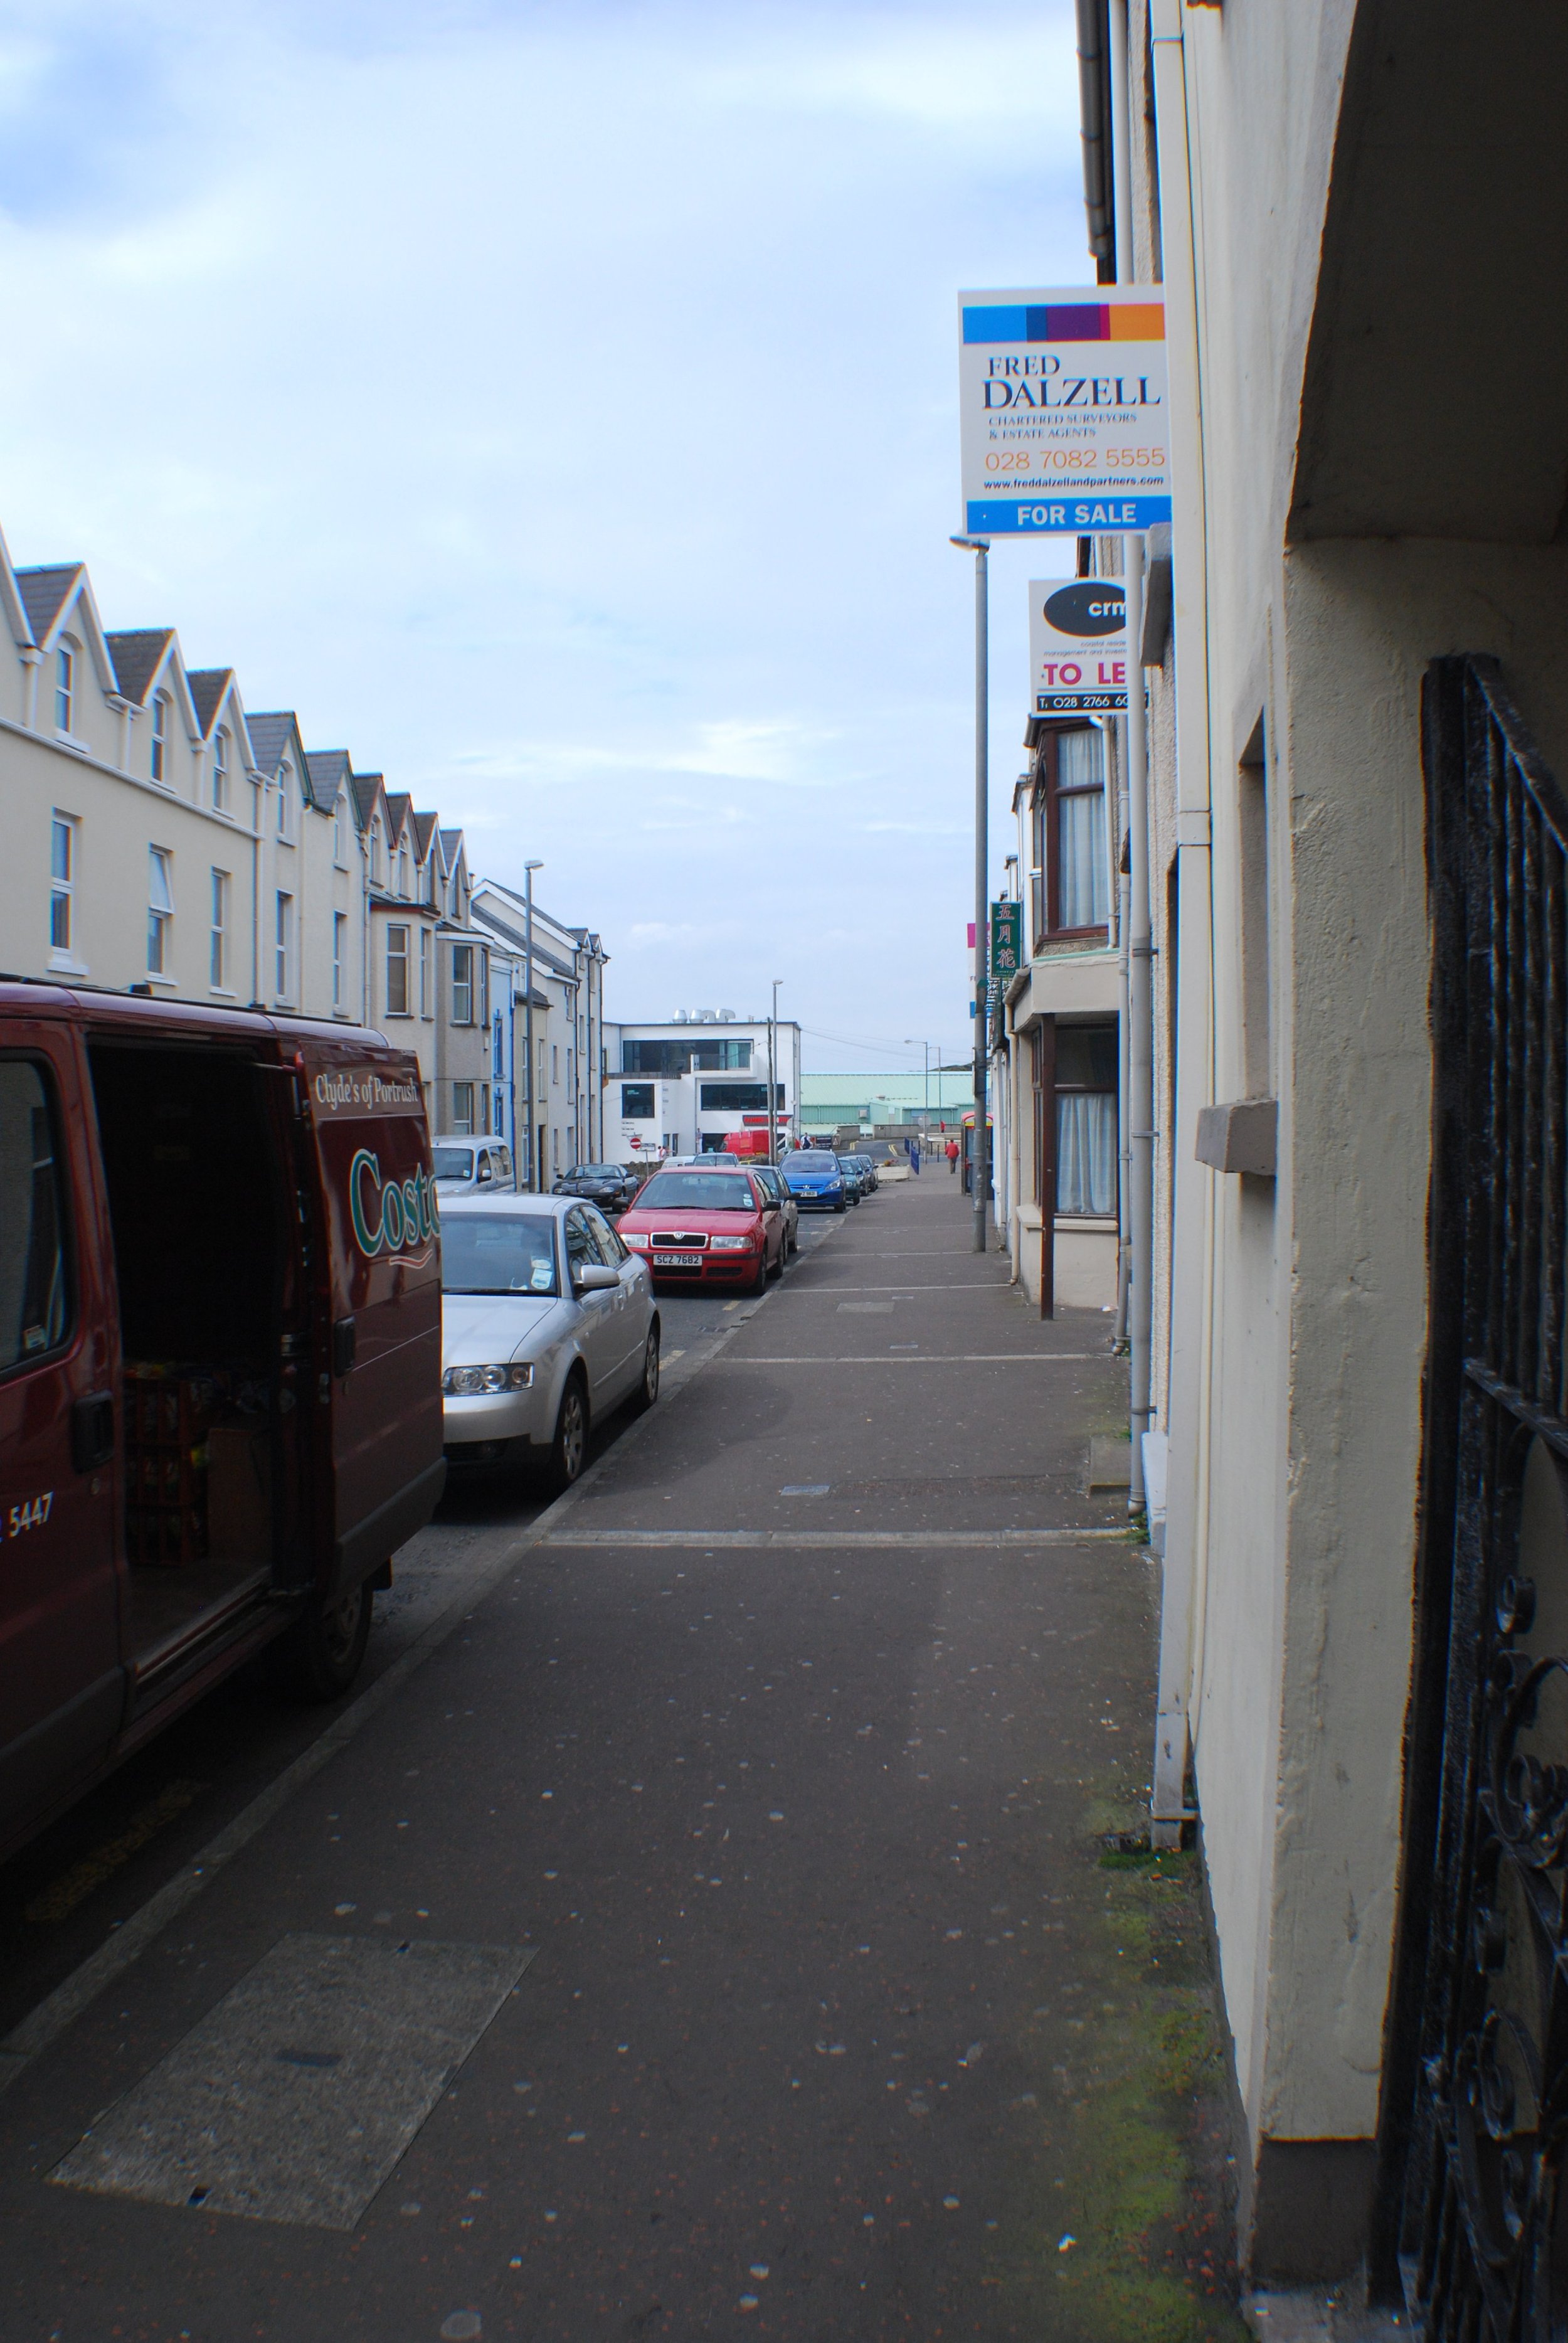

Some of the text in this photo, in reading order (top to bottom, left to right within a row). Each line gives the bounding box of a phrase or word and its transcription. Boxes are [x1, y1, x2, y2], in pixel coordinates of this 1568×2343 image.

[988, 354, 1061, 376] FRED
[982, 376, 1161, 409] DALZELL
[988, 412, 1138, 427] CHARTERED SURVEYORS
[989, 426, 1096, 440] & ESTATE AGENTS
[985, 447, 1165, 471] 028 7082 5555
[983, 476, 1164, 491] www.freddalzellandpartners.com
[1017, 503, 1137, 526] FOR SALE
[1044, 662, 1126, 686] TO LE
[1053, 696, 1078, 708] 028
[1083, 696, 1110, 708] 2766
[995, 904, 1016, 969] 五月花
[315, 1073, 418, 1110] Clyde's of Portrush
[657, 1255, 699, 1264] SCZ 7682
[9, 1491, 54, 1538] 5447
